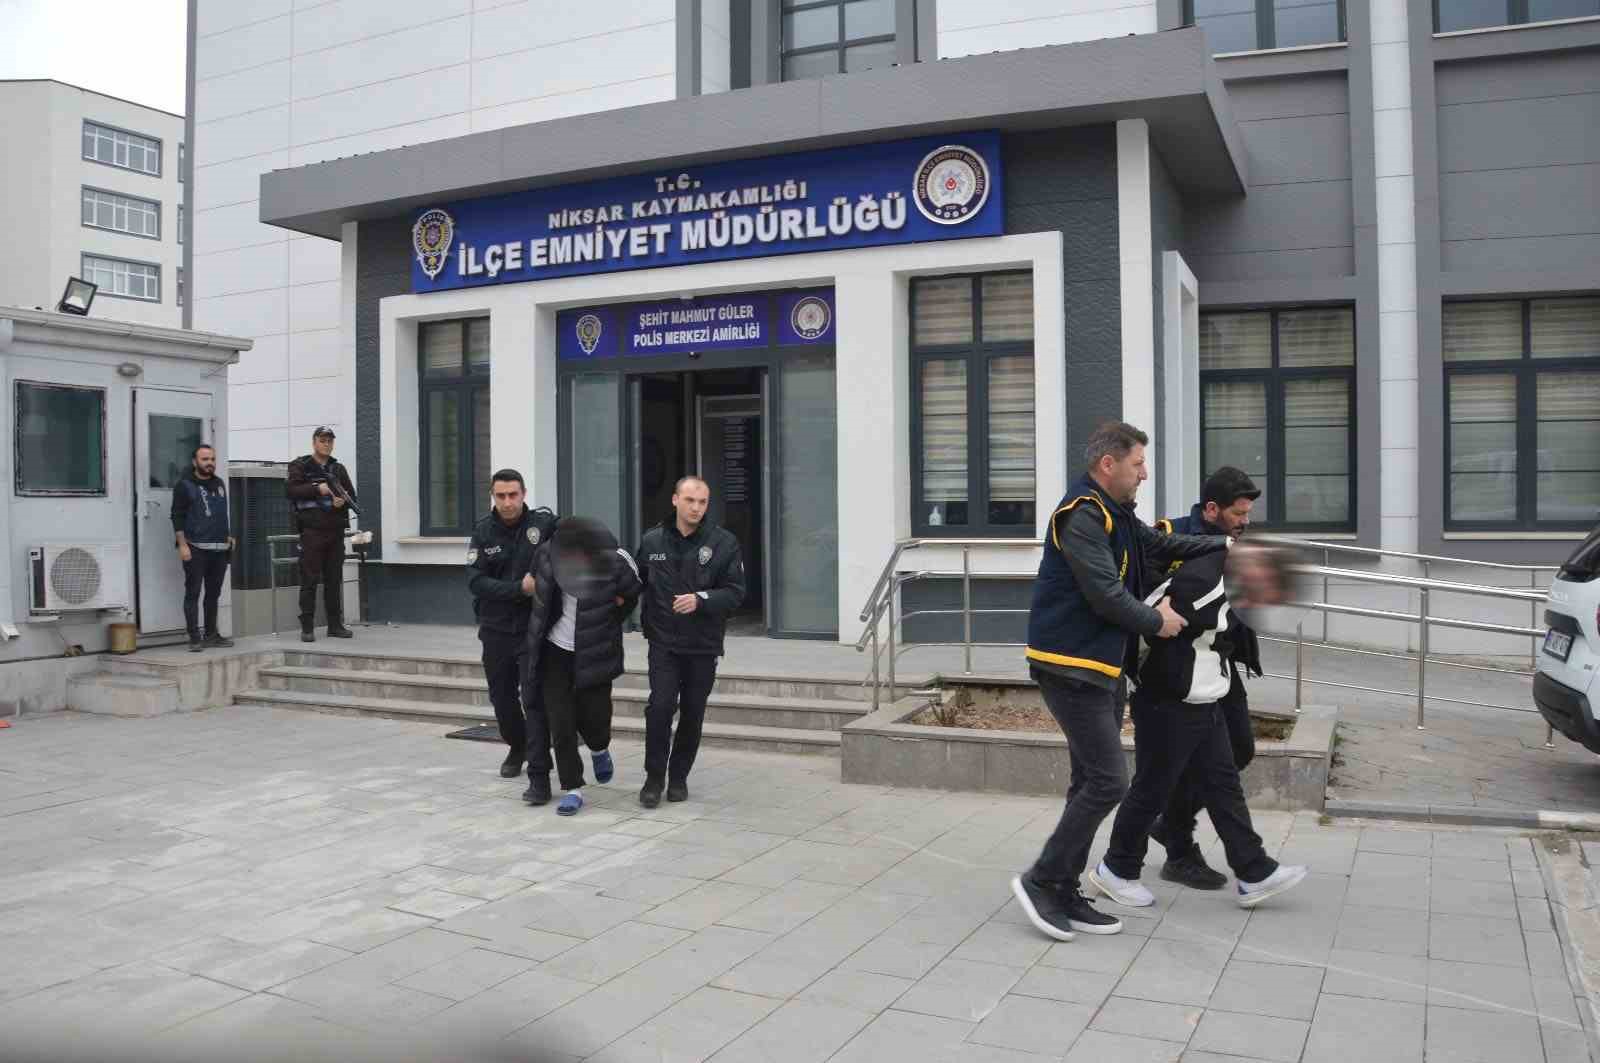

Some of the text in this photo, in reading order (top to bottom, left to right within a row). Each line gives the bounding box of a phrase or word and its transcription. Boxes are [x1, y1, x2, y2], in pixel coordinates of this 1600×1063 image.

[655, 174, 701, 193] T.C.
[548, 179, 807, 229] NİKSAR KAYMAKAMLIĞI
[458, 192, 907, 277] İLÇE EMNİYET MÜDÜRLÜĞÜ
[639, 304, 754, 329] ŞEHİT MAHMUT GÜLER
[633, 322, 760, 347] POLİS MERKEZİ AMİRLİĞİ
